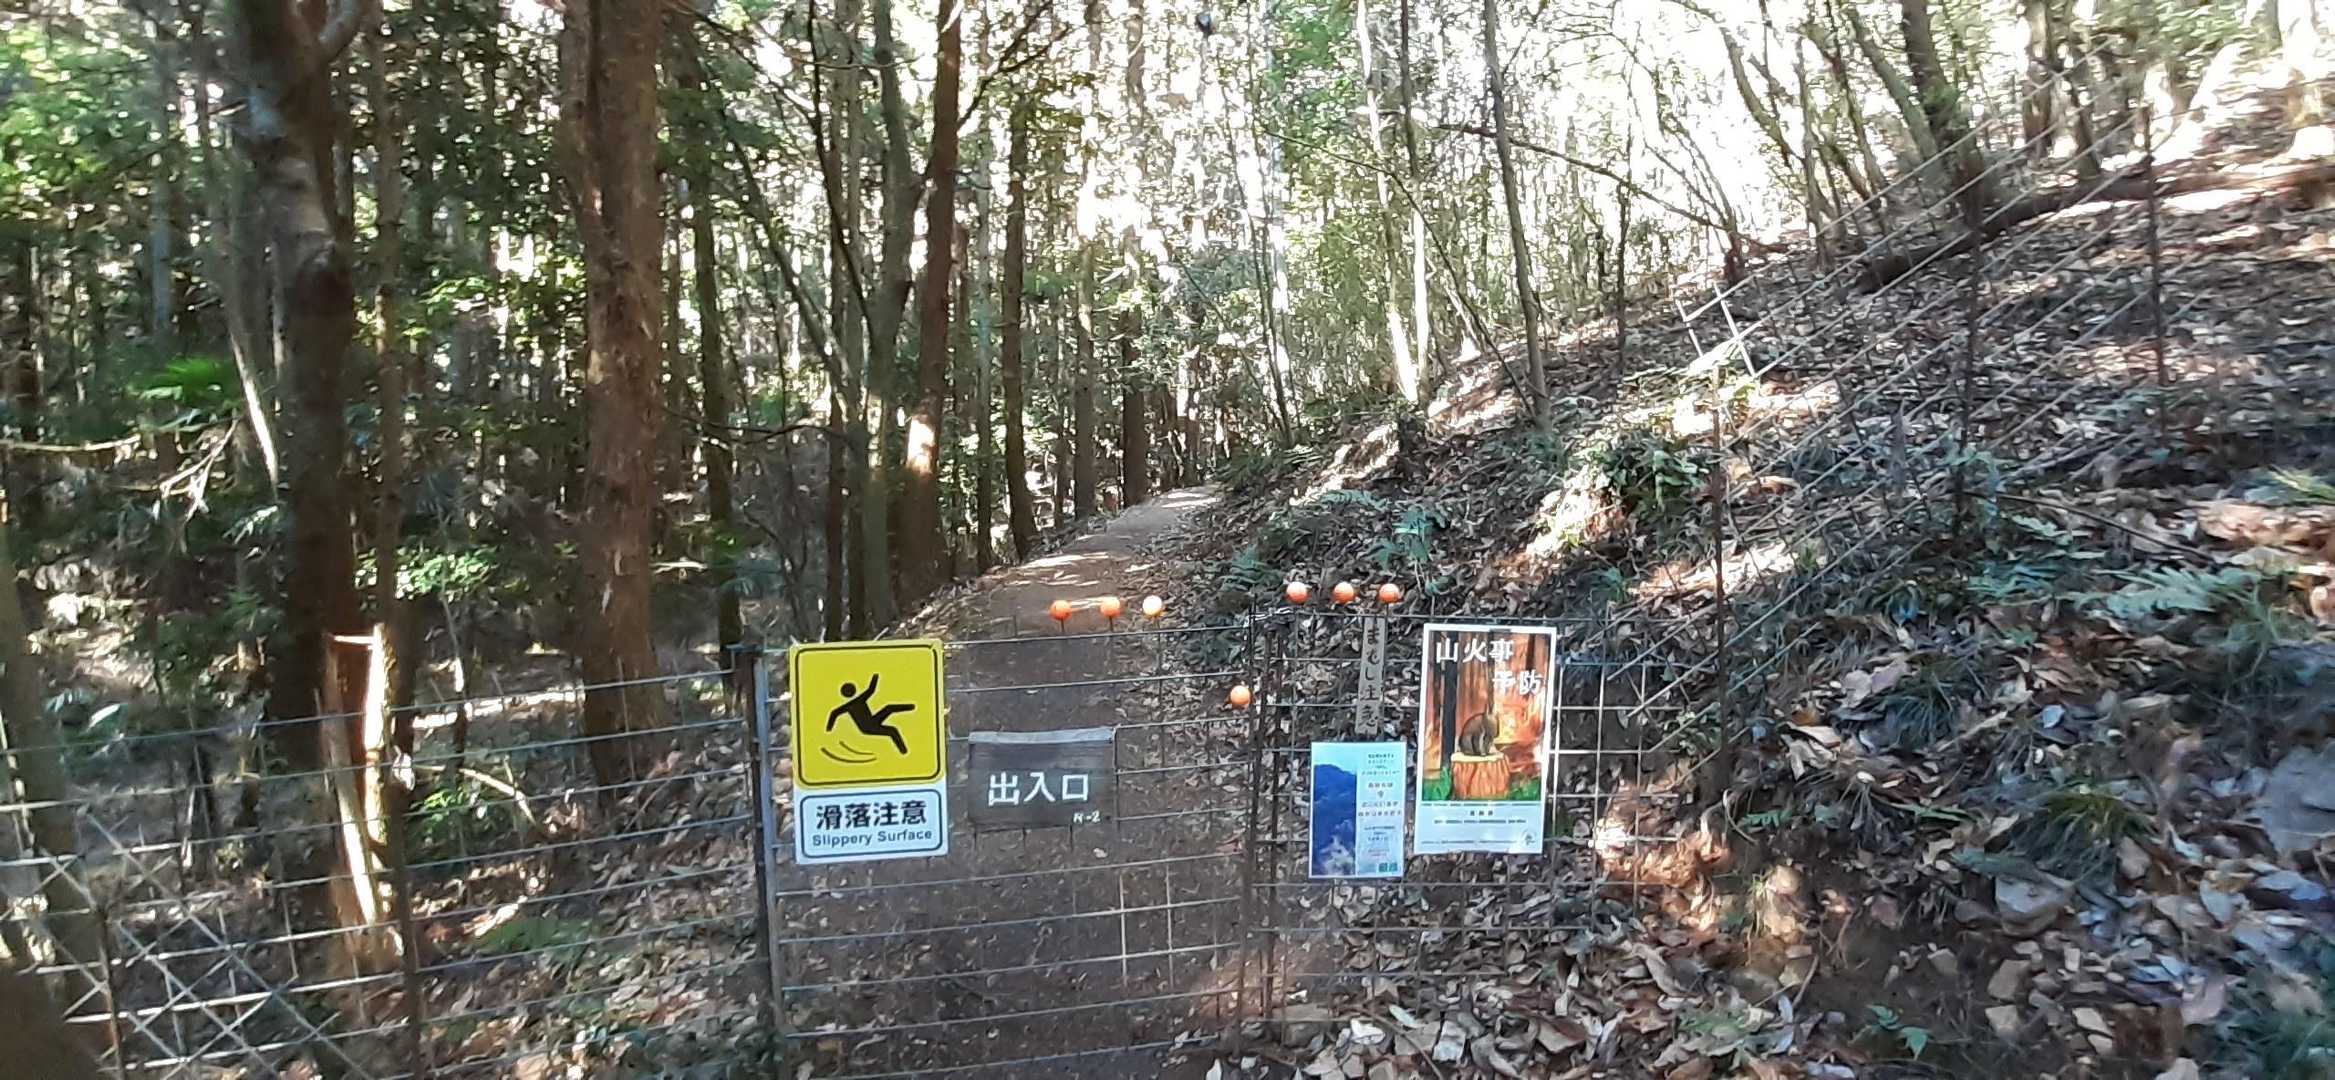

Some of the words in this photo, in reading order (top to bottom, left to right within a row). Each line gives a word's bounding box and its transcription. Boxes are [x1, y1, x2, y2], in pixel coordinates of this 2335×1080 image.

[1435, 637, 1515, 664] 山火事
[1492, 668, 1543, 696] 予防
[987, 771, 1089, 807] 出入口
[815, 799, 928, 831] 滑落注意
[812, 832, 873, 848] Slippery
[877, 829, 933, 842] Surface
